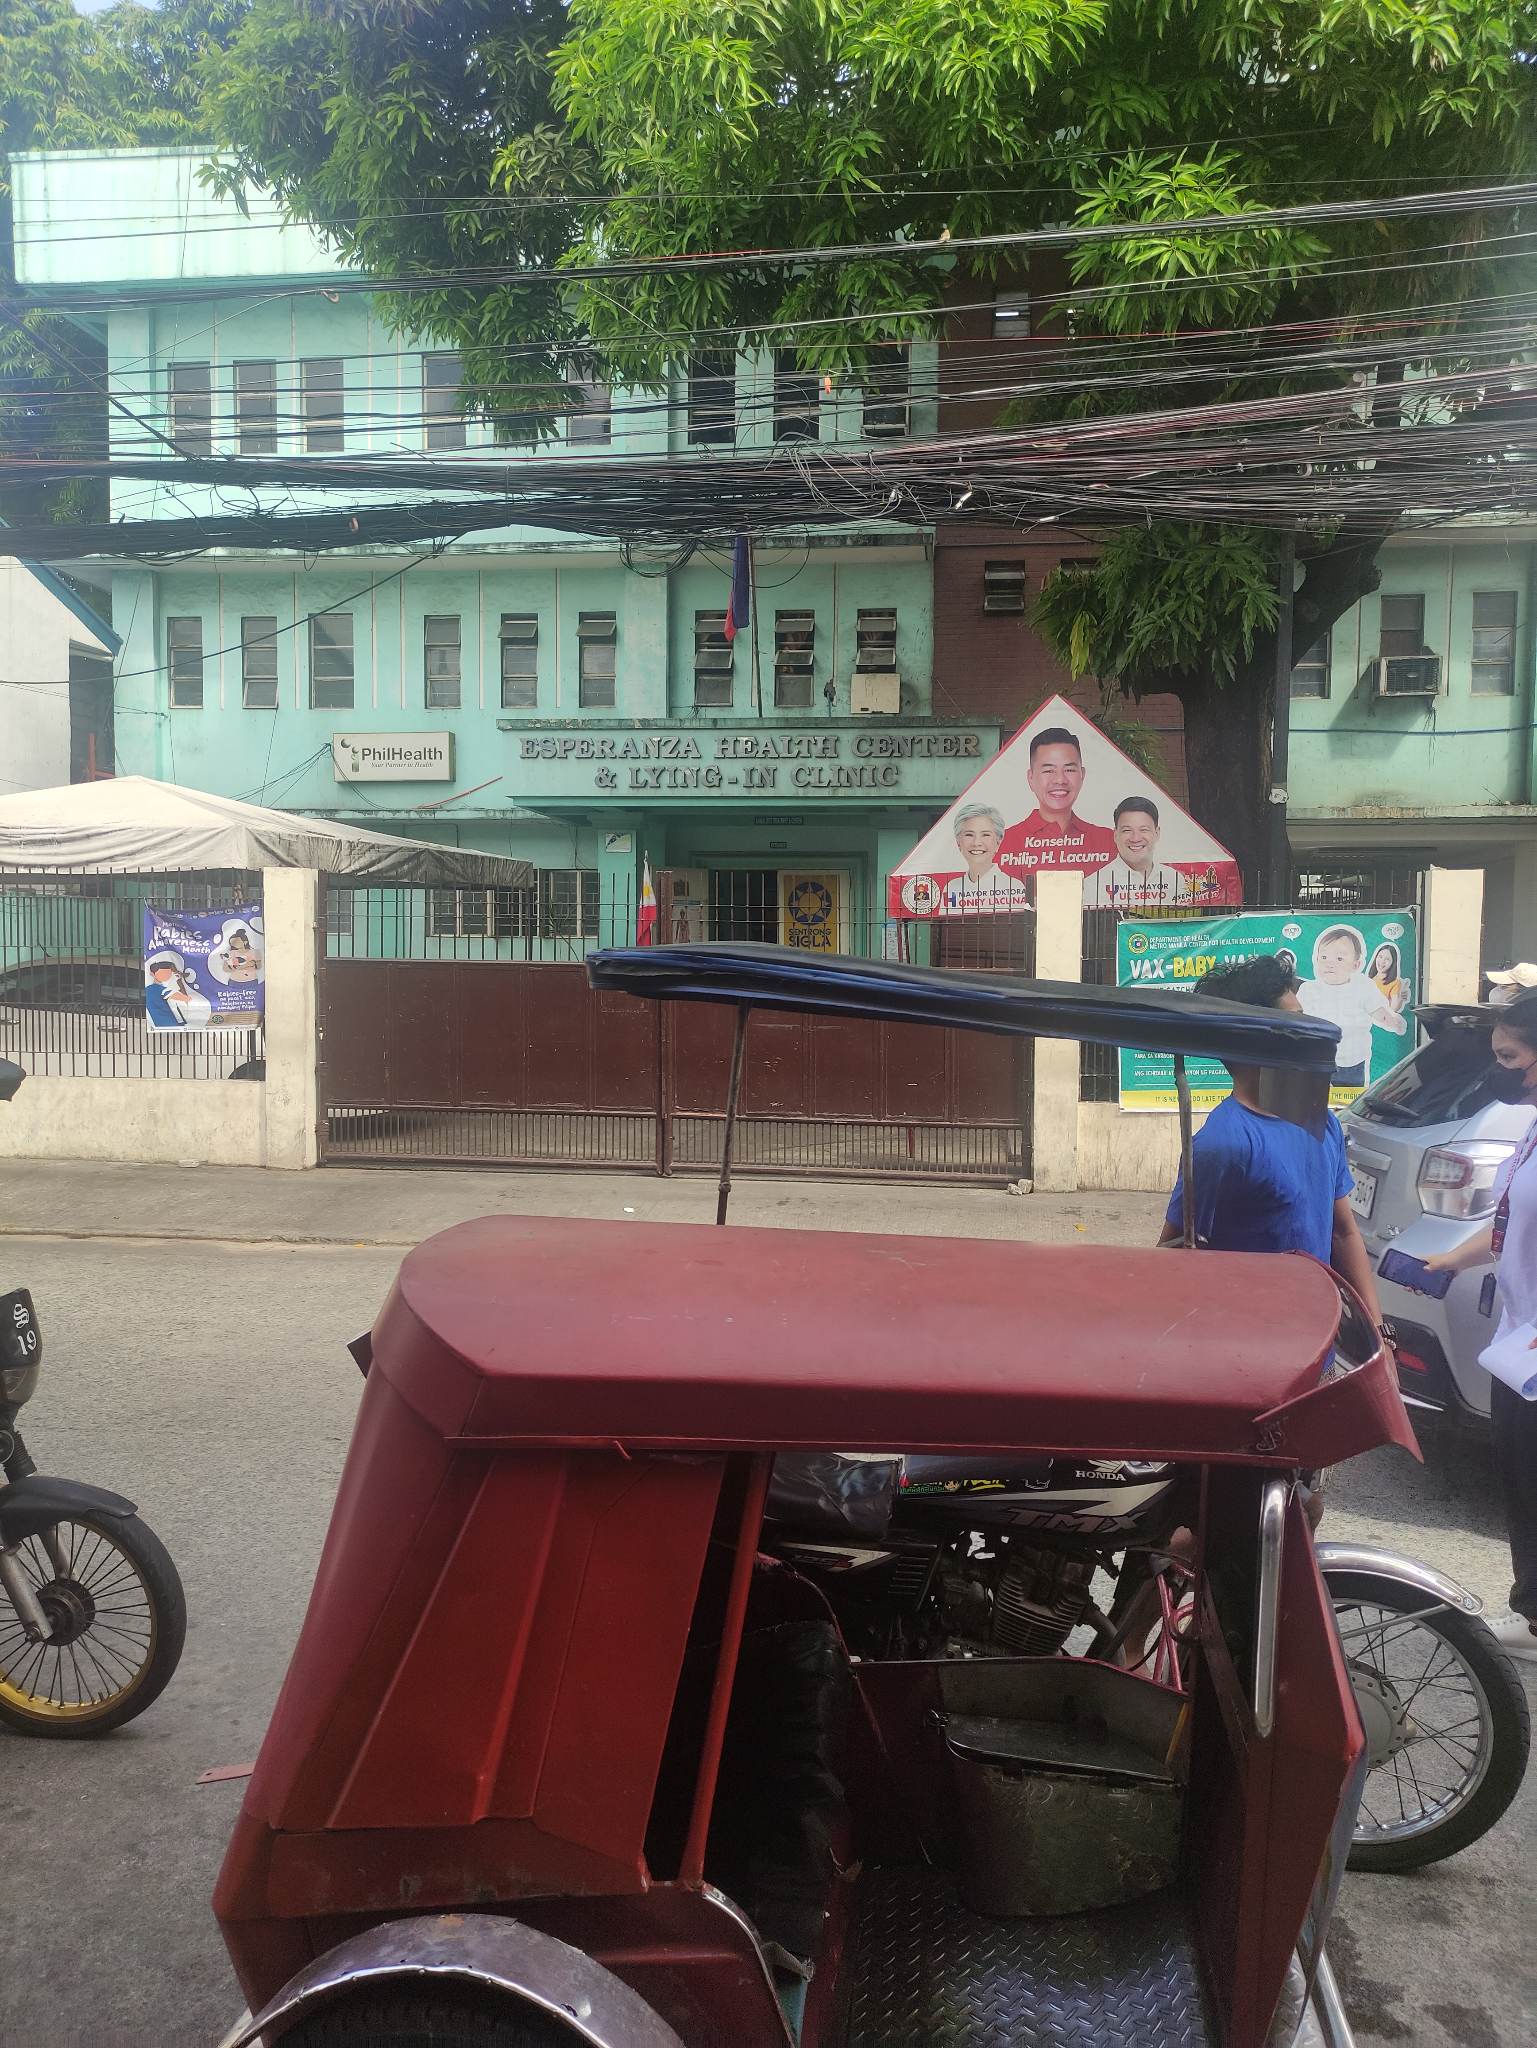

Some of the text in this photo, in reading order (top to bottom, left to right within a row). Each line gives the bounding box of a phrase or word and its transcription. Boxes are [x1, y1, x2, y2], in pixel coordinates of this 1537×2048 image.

[519, 734, 981, 759] ESPERANZA HEALTH CENTER
[361, 746, 443, 761] PhilHealth
[595, 766, 617, 788] &
[791, 765, 899, 788] CLINIC
[1024, 833, 1085, 848] Konsehal
[1000, 850, 1110, 868] Philip H. Lacuna
[958, 888, 1026, 899] MAYOR DOKTORA
[1138, 883, 1169, 891] MAYOR
[988, 896, 1027, 906] LACUNA
[1134, 891, 1167, 900] SERVO
[153, 925, 202, 940] Rabies
[788, 928, 833, 936] SENTRONG
[148, 939, 210, 951] Awareness
[788, 935, 833, 948] SIGLA
[182, 946, 210, 954] Month
[17, 1329, 37, 1355] 19
[1075, 1470, 1127, 1482] HONDA
[1007, 1508, 1147, 1534] TMX
